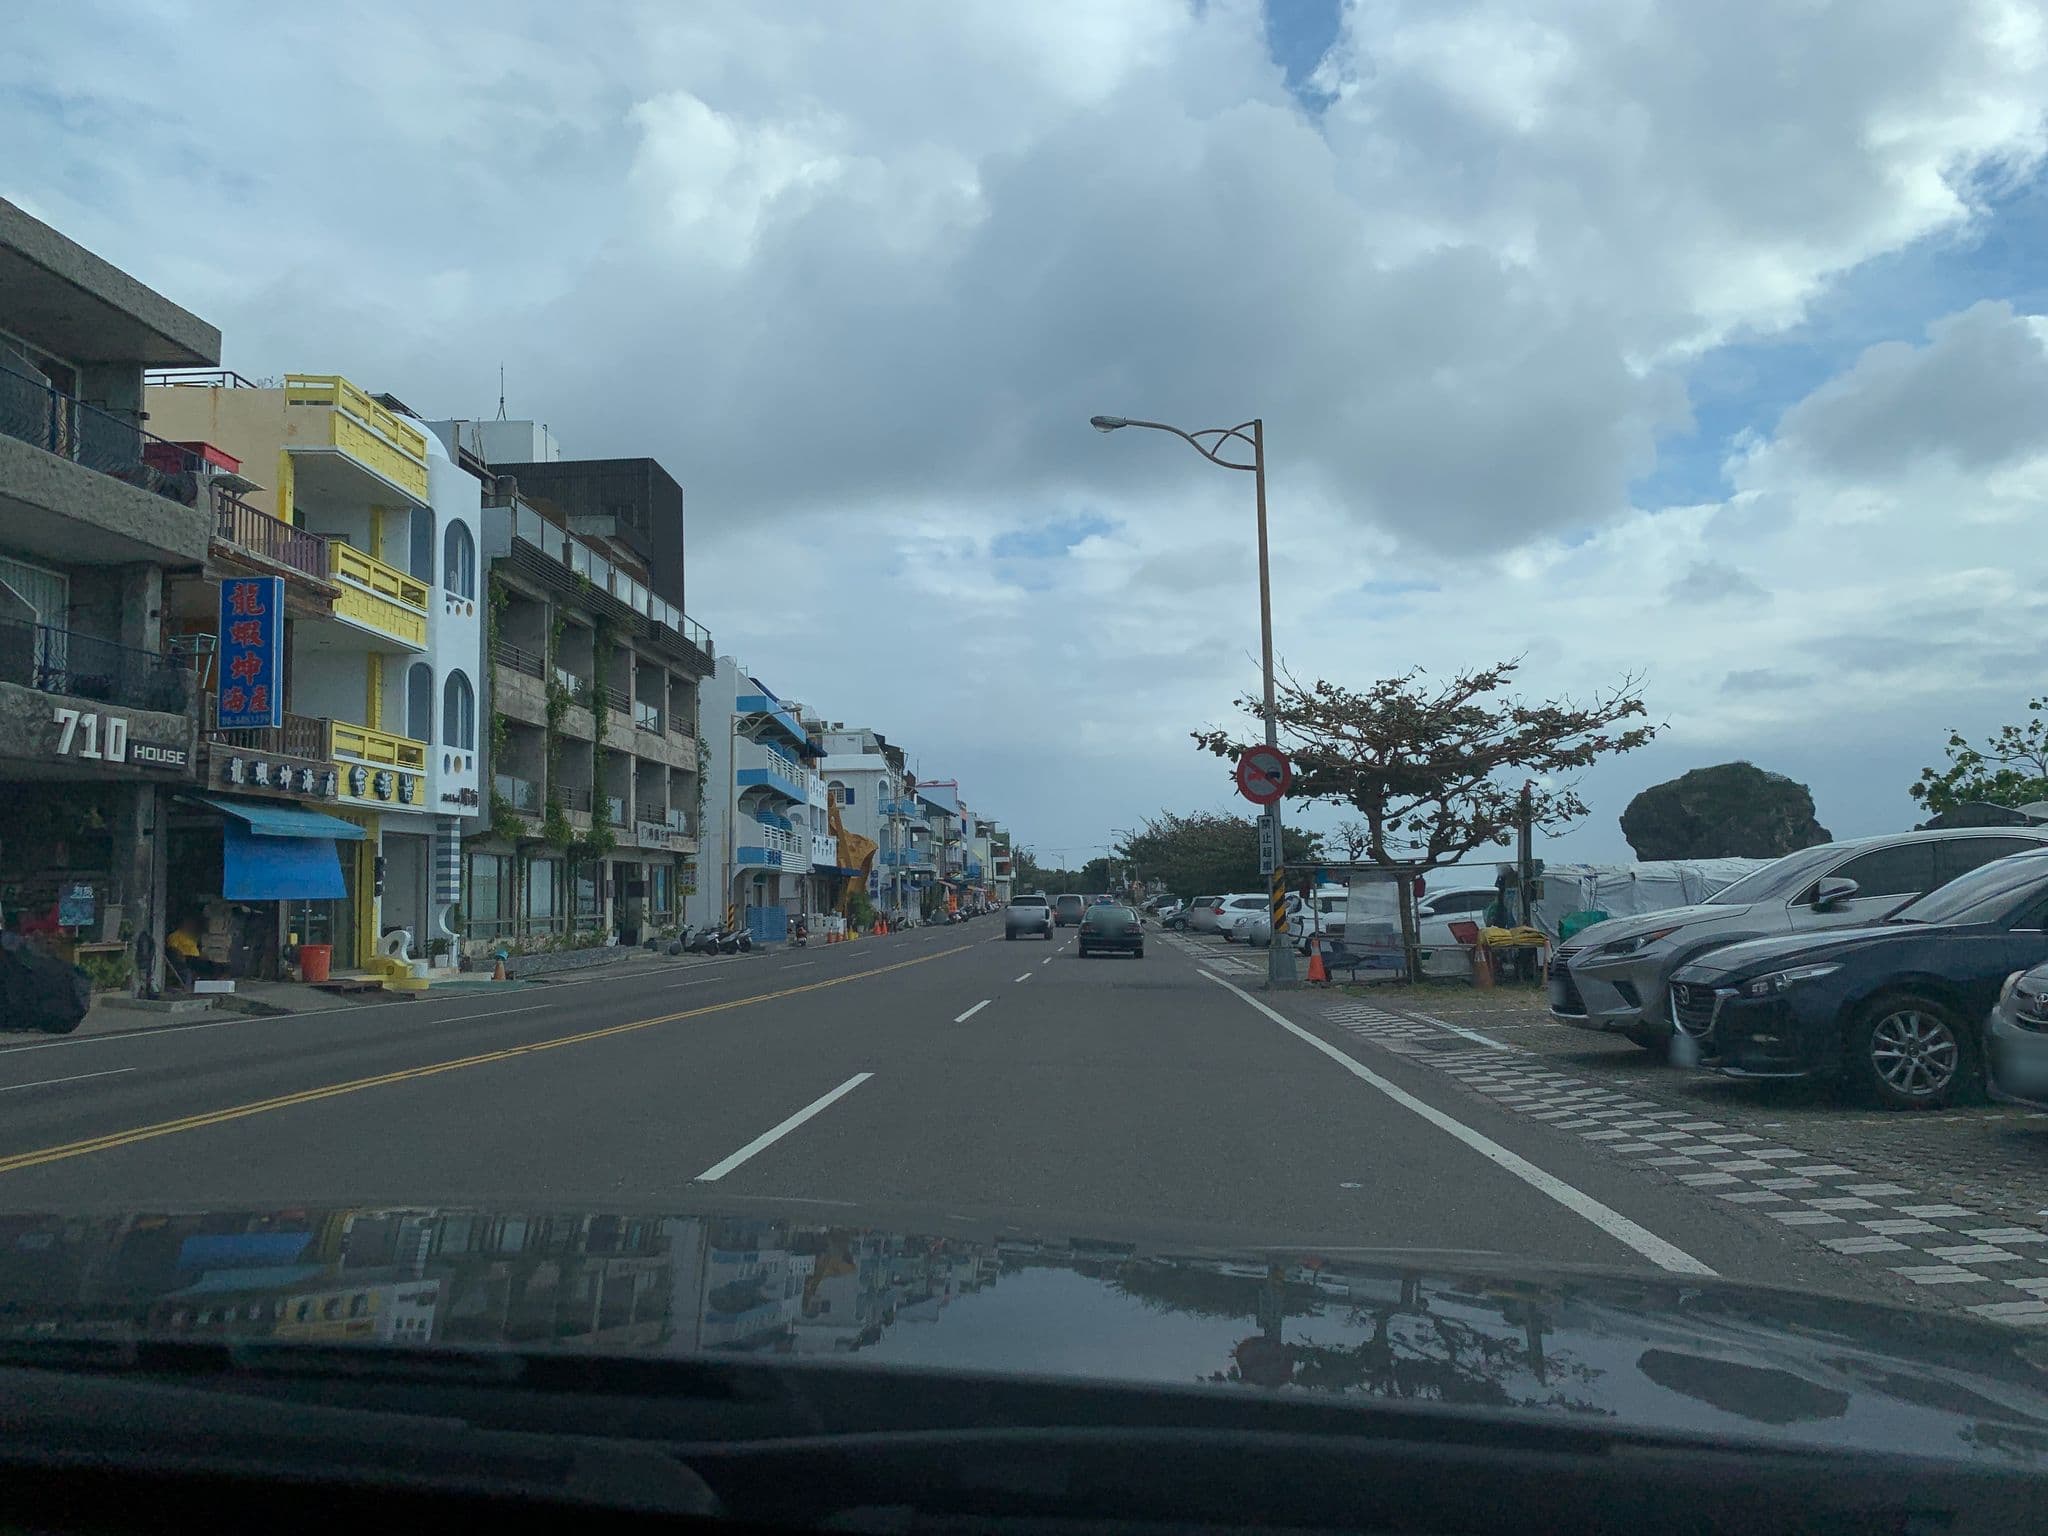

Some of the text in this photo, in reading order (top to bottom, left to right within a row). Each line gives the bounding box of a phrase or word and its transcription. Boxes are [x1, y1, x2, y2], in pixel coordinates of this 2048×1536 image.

[228, 582, 266, 686] 龍蝦坤
[222, 684, 271, 713] 海產
[53, 707, 187, 765] 710 HOUSE
[229, 756, 336, 796] 龍蝦坤海產
[1260, 818, 1272, 871] 禁止超車
